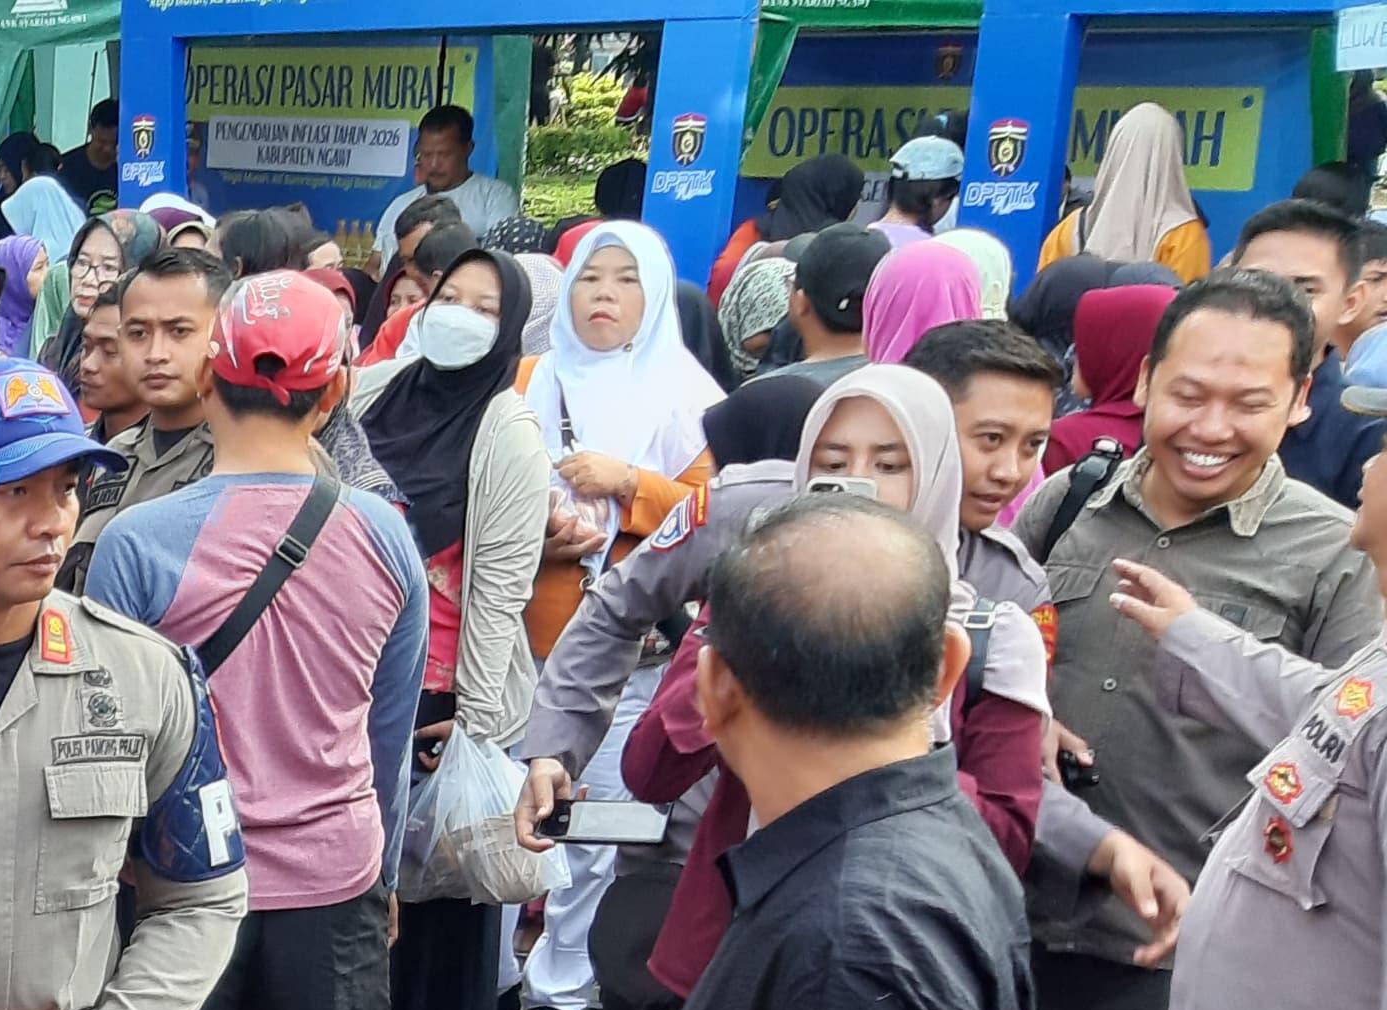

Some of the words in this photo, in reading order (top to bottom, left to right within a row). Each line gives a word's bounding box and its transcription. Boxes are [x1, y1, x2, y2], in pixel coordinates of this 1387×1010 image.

[279, 65, 353, 108] PASAR
[331, 126, 367, 145] TAHUN
[368, 128, 400, 147] 2026
[768, 106, 925, 159] OPERAS
[256, 146, 315, 167] KABUPATEN
[1300, 712, 1346, 764] POLRI
